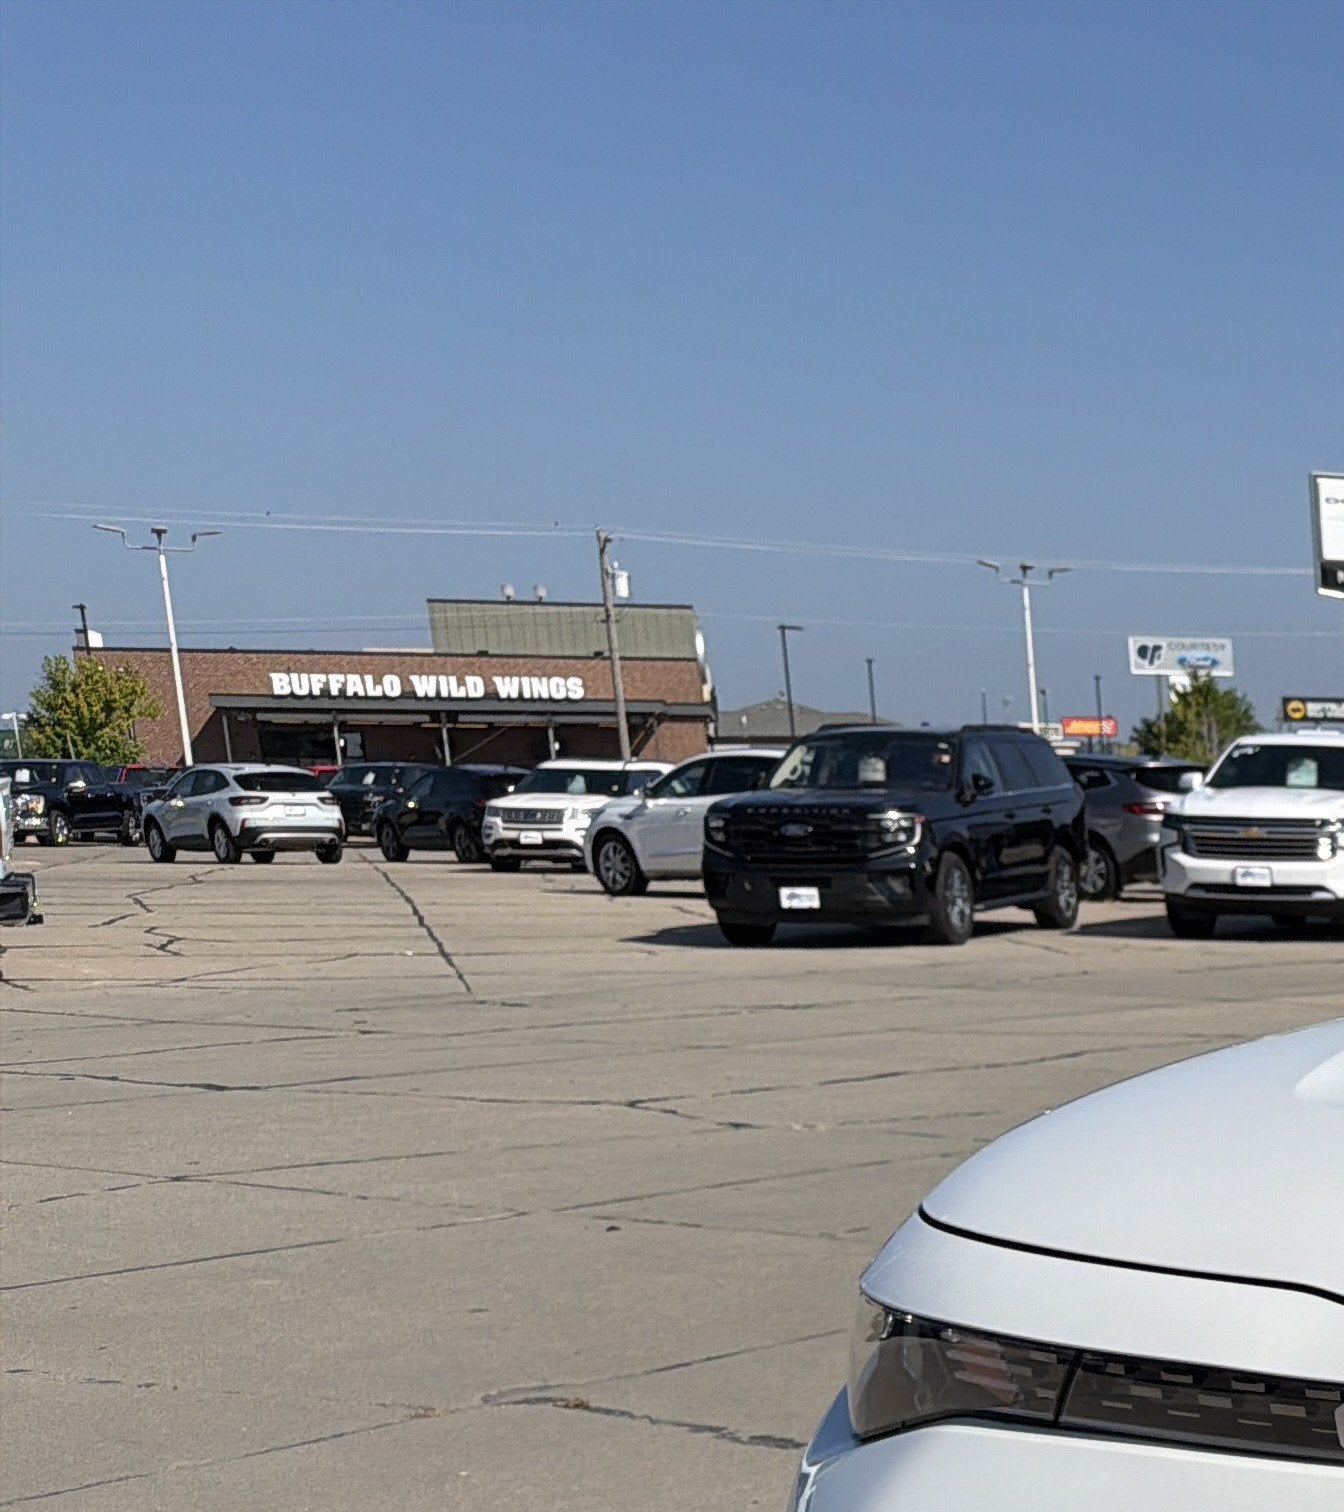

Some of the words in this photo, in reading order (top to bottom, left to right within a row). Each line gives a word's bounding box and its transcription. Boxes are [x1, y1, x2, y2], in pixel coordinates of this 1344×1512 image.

[268, 672, 402, 697] BUFFALO
[409, 674, 485, 699] WILD
[492, 675, 586, 700] WINGS
